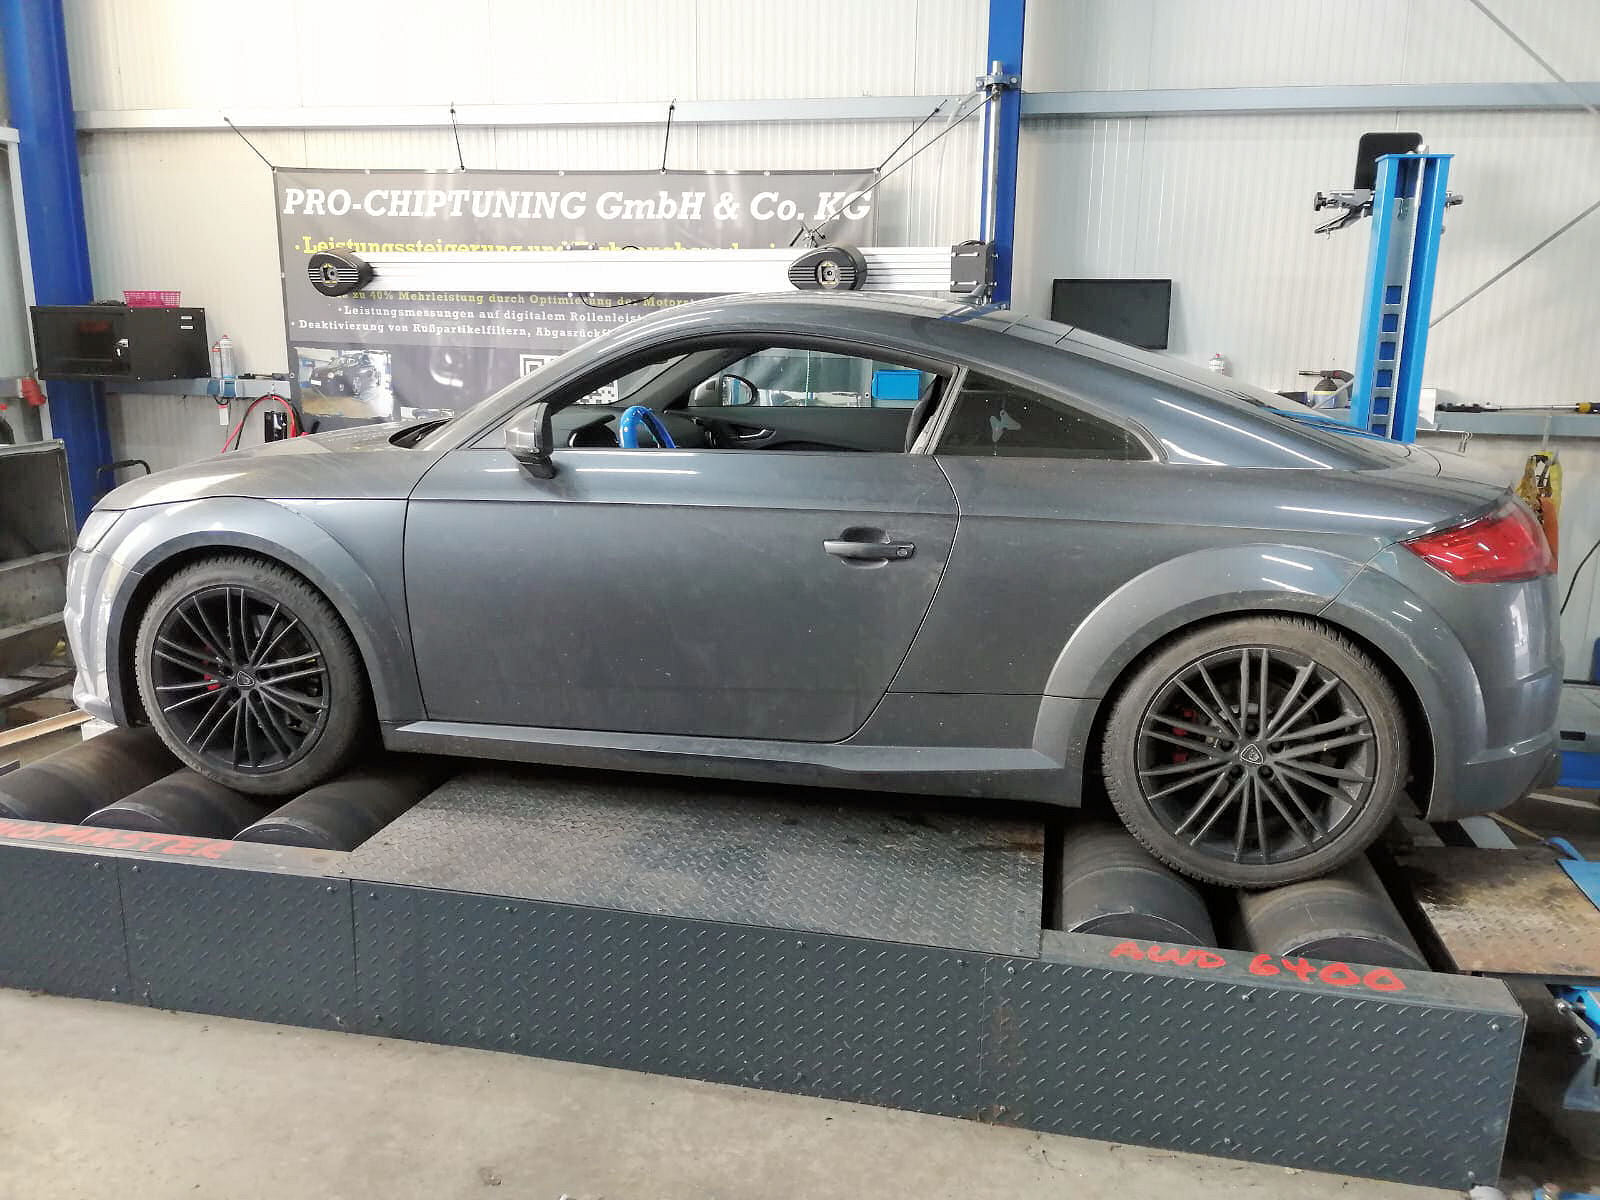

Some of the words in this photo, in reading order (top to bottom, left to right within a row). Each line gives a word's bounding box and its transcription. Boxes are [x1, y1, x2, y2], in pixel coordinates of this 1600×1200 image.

[282, 187, 587, 220] PRO-CHIPTUNING
[595, 190, 706, 221] GmbH
[713, 191, 740, 221] &
[750, 191, 805, 221] Co.
[813, 191, 872, 222] KG
[399, 291, 484, 304] Mehrleistung
[488, 293, 525, 304] durch
[529, 294, 612, 307] Optimierung
[344, 305, 475, 320] Leistungsmessungen
[479, 309, 500, 320] auf
[503, 310, 566, 322] digitalem
[298, 319, 385, 333] Deaktivierung
[388, 322, 409, 332] von
[1249, 953, 1407, 992] 6400
